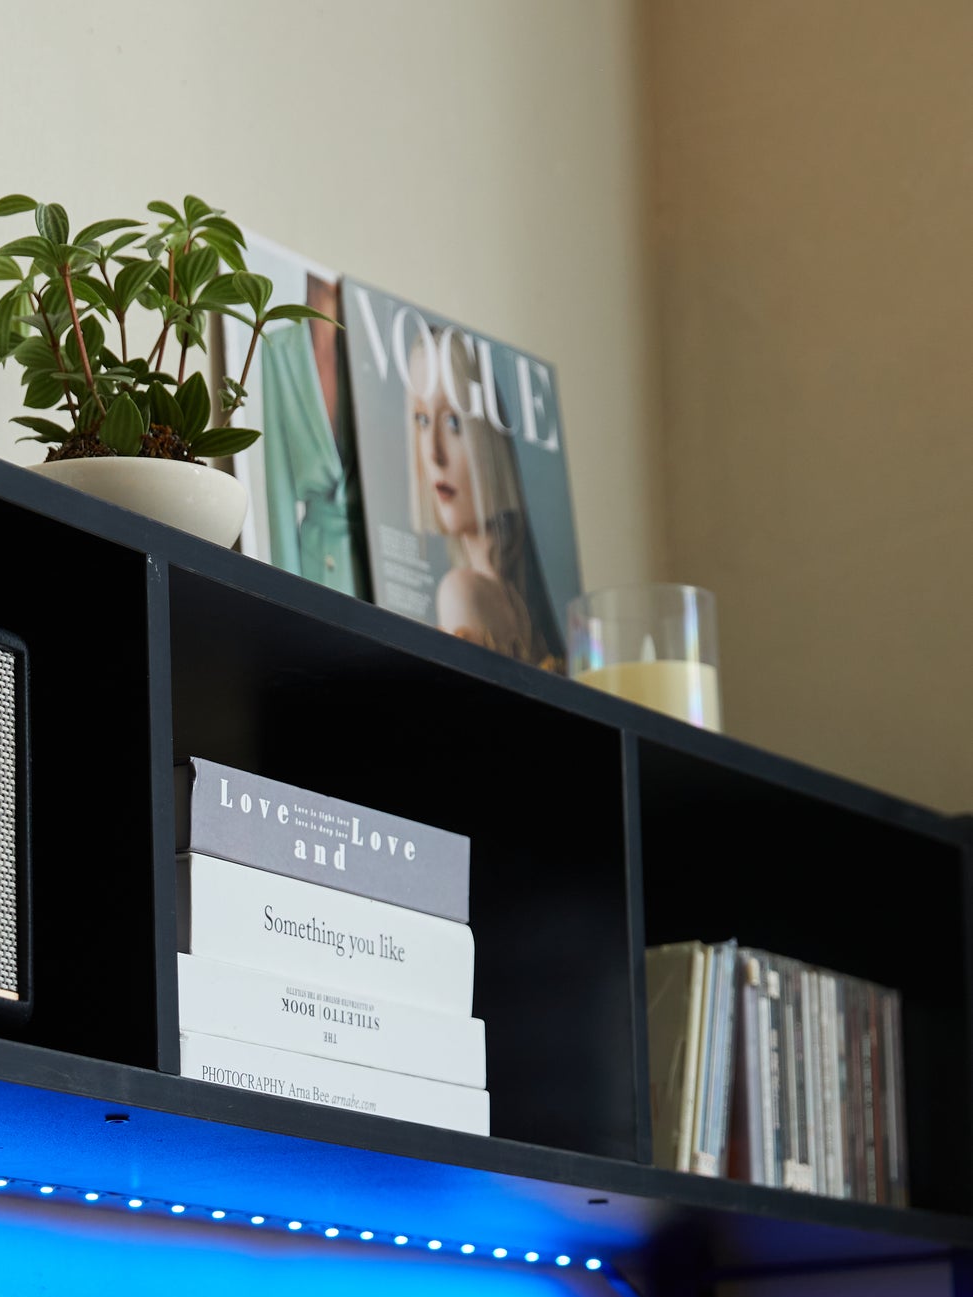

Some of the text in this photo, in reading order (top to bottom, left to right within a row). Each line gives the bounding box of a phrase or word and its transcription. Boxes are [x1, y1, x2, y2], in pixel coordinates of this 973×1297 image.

[355, 286, 560, 452] VOGUE
[220, 778, 416, 861] Love Love
[294, 839, 346, 871] and
[264, 905, 406, 963] Something you like
[281, 998, 380, 1031] STILETTO BOOK
[323, 1031, 338, 1044] THE
[288, 1083, 311, 1100] Arna
[313, 1086, 330, 1103] Bee
